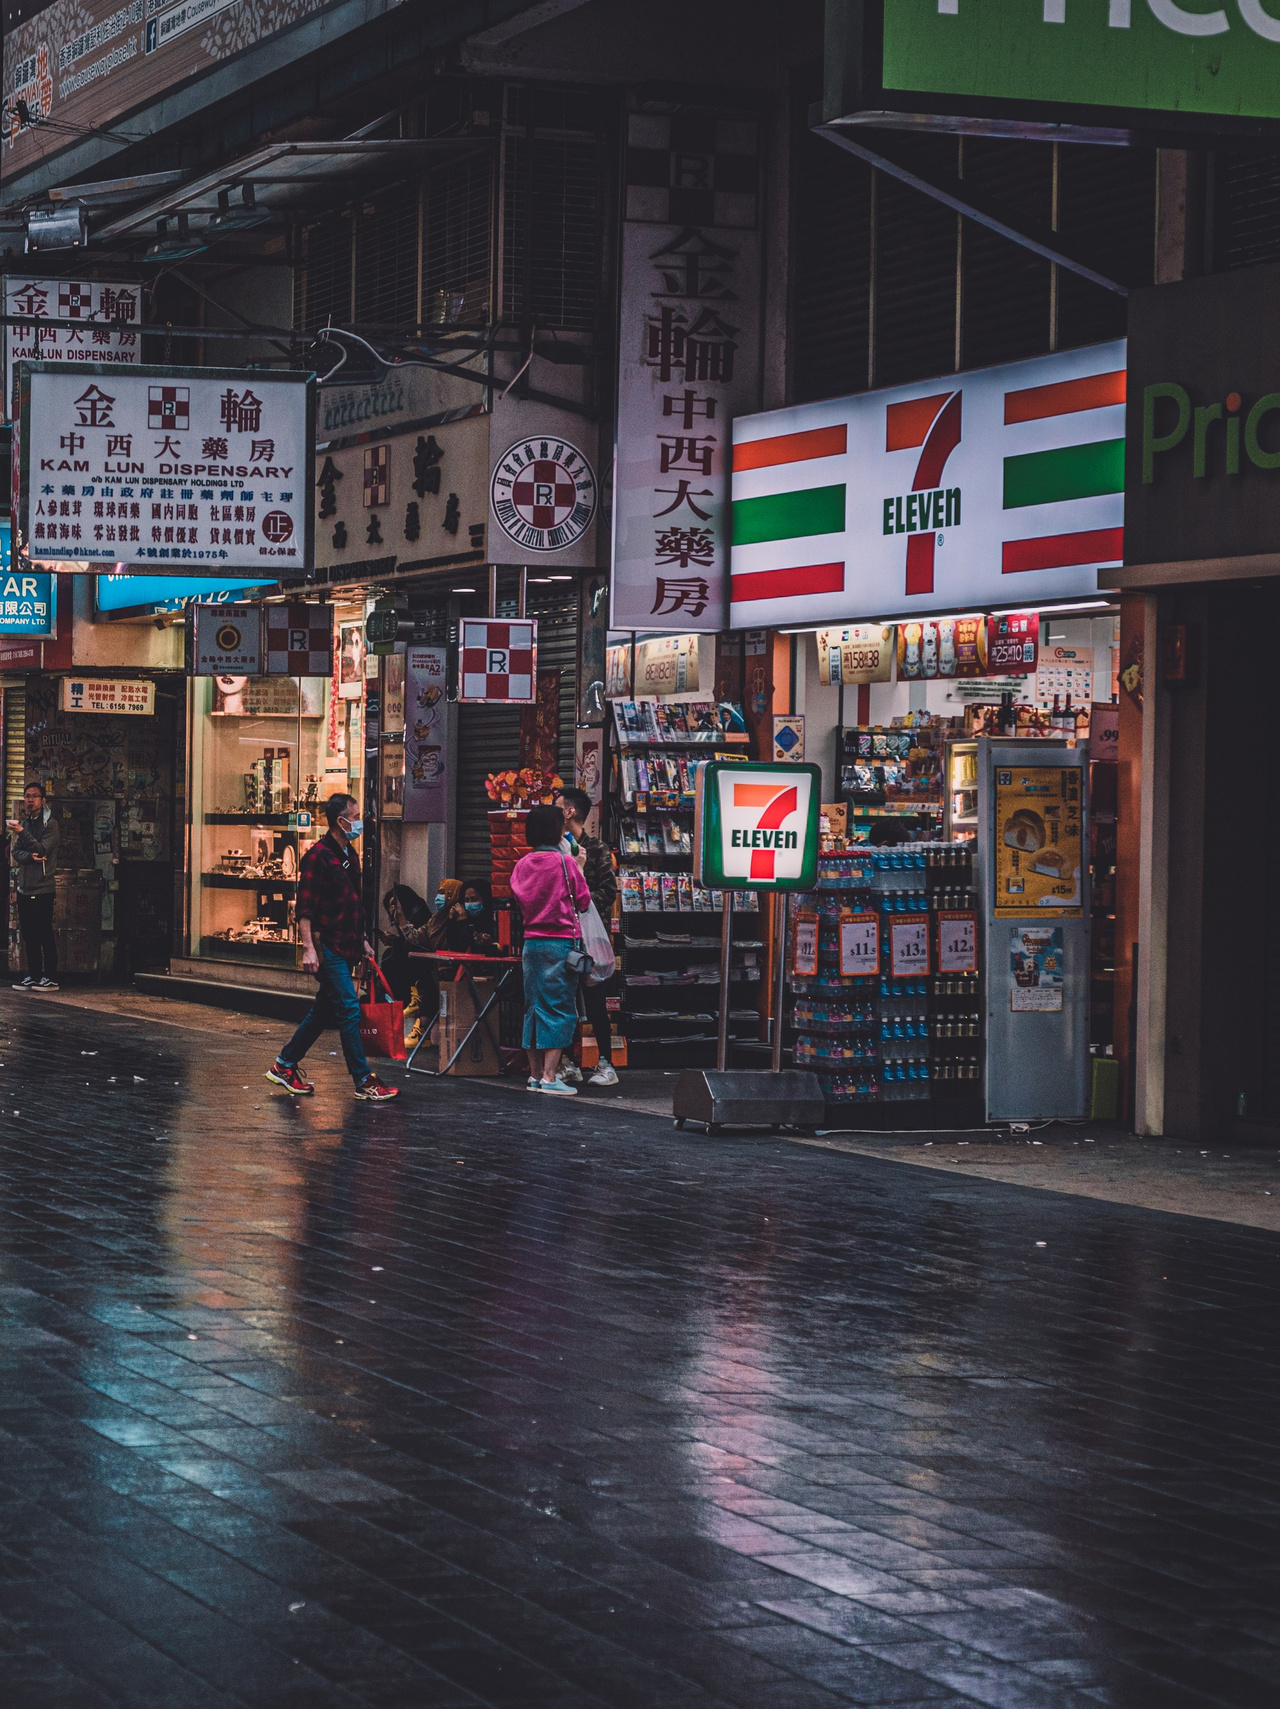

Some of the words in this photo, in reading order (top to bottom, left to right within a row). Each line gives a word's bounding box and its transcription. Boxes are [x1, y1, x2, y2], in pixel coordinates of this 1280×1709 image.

[12, 284, 49, 316] 金
[100, 287, 137, 320] 輪
[12, 325, 138, 346] 中西大藥房
[12, 347, 36, 359] KAM
[41, 349, 63, 360] LUN
[67, 350, 135, 362] DISPENSARY
[73, 383, 116, 429] 金
[220, 388, 263, 433] 輪
[60, 431, 276, 463] 中西大藥房
[40, 459, 90, 472] KAM
[104, 461, 145, 474] LUN
[159, 463, 294, 479] DISPENSARY
[105, 476, 124, 485] KAM
[125, 477, 140, 485] LUN
[142, 477, 188, 486] DISPENSARY
[191, 478, 229, 488] HOLDINGS
[230, 480, 245, 489] LTD
[210, 504, 257, 523] 社區藥房
[34, 546, 115, 558] kamlundisp@hknet.com
[128, 703, 144, 711] 7969
[734, 784, 797, 879] 7
